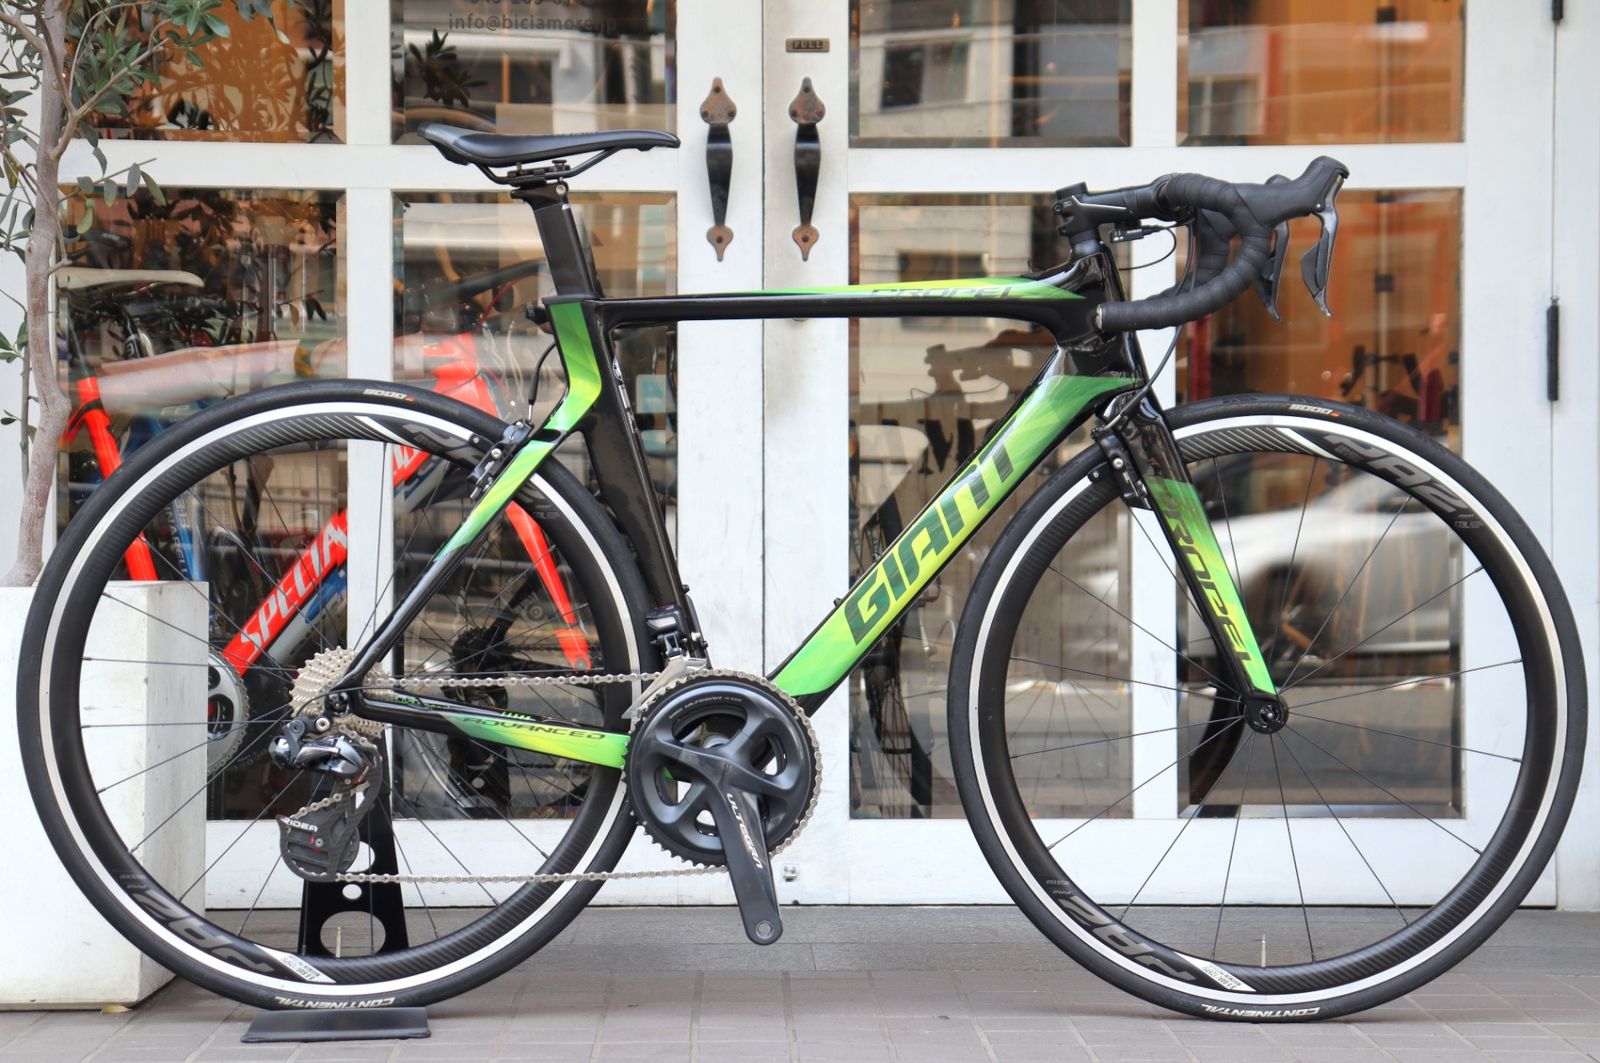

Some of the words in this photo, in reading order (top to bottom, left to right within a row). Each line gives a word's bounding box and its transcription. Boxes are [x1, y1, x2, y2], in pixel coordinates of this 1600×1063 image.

[844, 414, 1018, 646] GIANT
[240, 508, 348, 661] SPECIA
[463, 716, 606, 740] ADVANCED
[726, 792, 764, 870] ULTEGRA
[274, 996, 395, 1009] CONTINENTAL
[1200, 1003, 1321, 1017] CONTINENTAL
